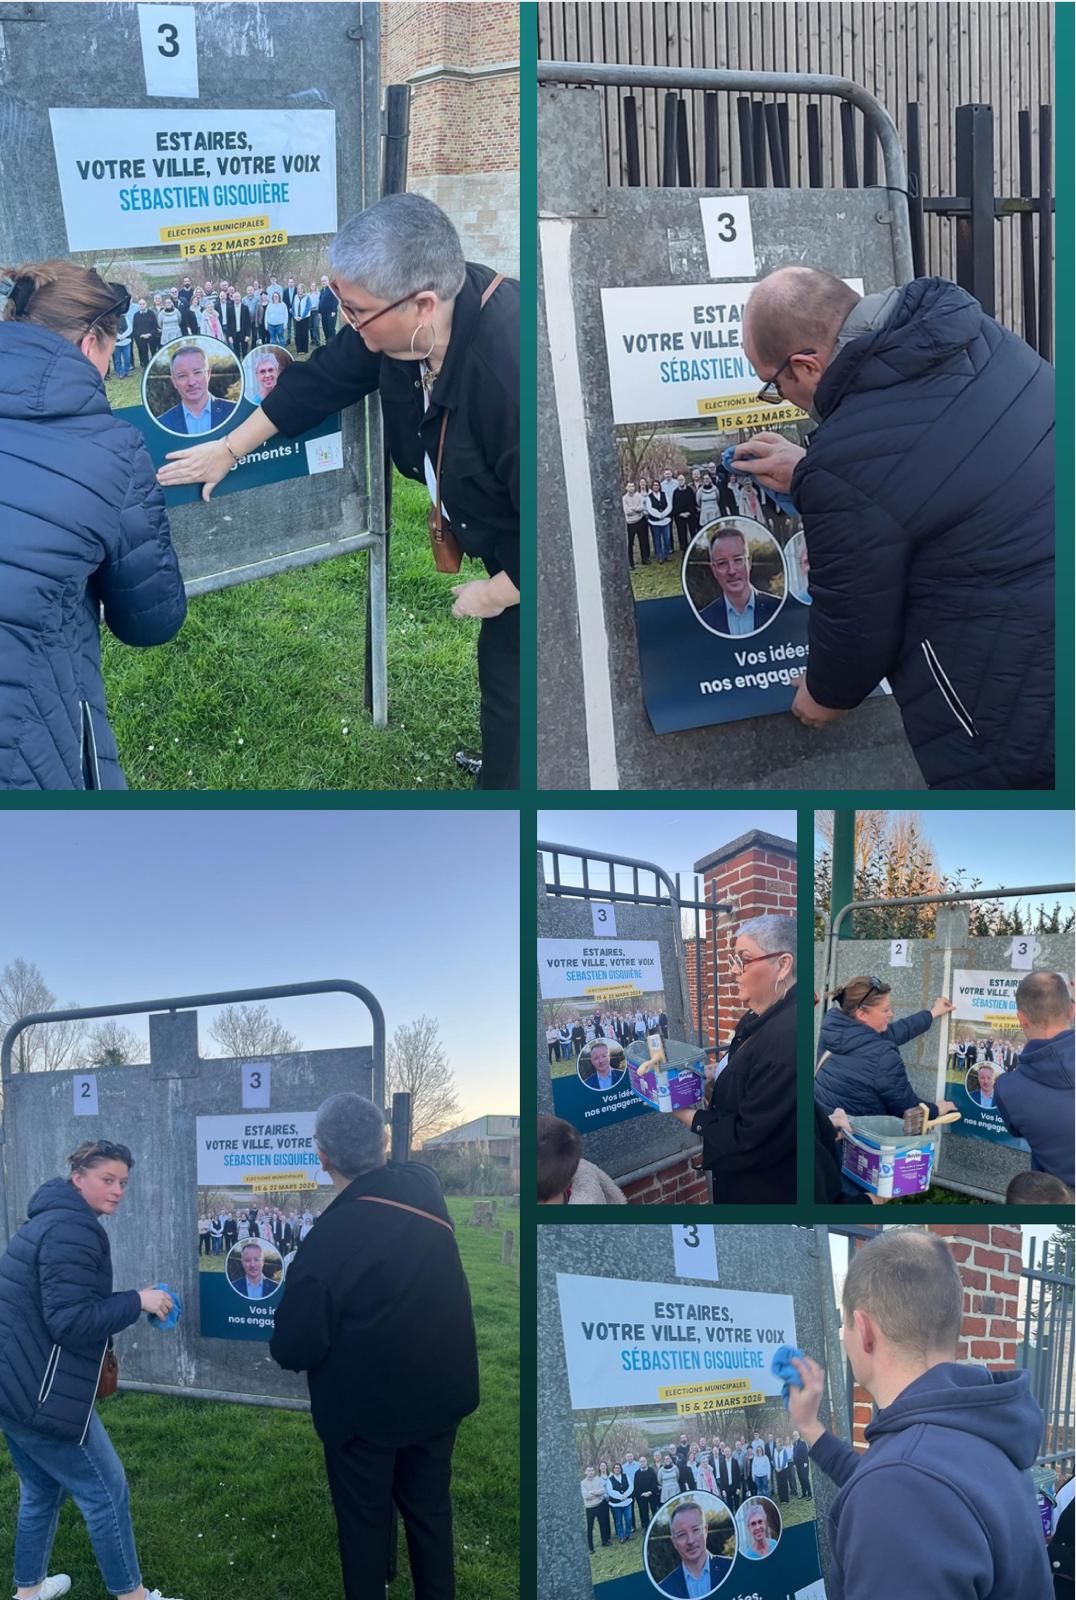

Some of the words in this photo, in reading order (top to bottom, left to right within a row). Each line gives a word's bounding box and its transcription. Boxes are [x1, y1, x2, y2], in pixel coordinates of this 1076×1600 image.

[157, 24, 180, 57] 3
[156, 131, 253, 151] ESTAIRES,
[76, 159, 146, 180] VOTRE
[152, 157, 211, 178] VILLE,
[217, 156, 276, 175] VOTRE
[283, 154, 321, 173] VOIX
[119, 184, 209, 211] SÉBASTIEN
[213, 180, 290, 207] GISQUIÈRE
[167, 225, 211, 238] ELECTIONS
[213, 219, 265, 232] MUNICIPALES
[717, 212, 737, 242] 3
[184, 245, 196, 255] 15
[199, 243, 207, 253] &
[210, 241, 223, 252] 22
[225, 237, 256, 250] MARS
[258, 233, 284, 246] 2026
[622, 332, 684, 353] VOTRE
[660, 357, 744, 384] SÉBASTIEN
[704, 398, 746, 409] ELECTIONS
[721, 418, 732, 427] 15
[735, 416, 743, 425] &
[747, 414, 758, 424] 22
[762, 409, 791, 422] MARS
[734, 651, 767, 666] Vos
[700, 679, 732, 695] nos
[598, 909, 607, 921] 3
[583, 948, 625, 957] ESTAIRES,
[895, 944, 902, 954] 2
[1018, 943, 1028, 955] 3
[547, 959, 578, 967] VOTRE
[581, 958, 608, 967] VILLE,
[610, 958, 635, 966] VOTRE
[960, 987, 984, 995] VOTRE
[250, 1072, 261, 1088] 3
[81, 1082, 90, 1097] 2
[602, 1094, 617, 1103] Vos
[584, 1108, 600, 1118] nos
[963, 1117, 977, 1125] nos
[981, 1112, 994, 1121] Vos
[244, 1124, 298, 1136] ESTAIRES,
[205, 1140, 238, 1150] VOTRE
[242, 1139, 273, 1150] VILLE,
[277, 1137, 312, 1149] VOTRE
[223, 1153, 271, 1166] SÉBASTIEN
[273, 1150, 320, 1166] GISQUIÈRE
[682, 1224, 700, 1248] 3
[249, 1306, 267, 1315] Vos
[654, 1302, 734, 1324] ESTAIRES,
[581, 1322, 645, 1341] VOTRE
[651, 1325, 701, 1344] VILLE,
[705, 1326, 751, 1343] VOTRE
[756, 1329, 785, 1344] VOIX
[621, 1346, 700, 1371] SÉBASTIEN
[704, 1347, 765, 1370] GISQUIÈRE
[665, 1386, 703, 1397] ELECTIONS
[705, 1381, 747, 1392] MUNICIPALES
[680, 1403, 691, 1412] 15
[694, 1402, 700, 1411] &
[704, 1400, 714, 1410] 22
[716, 1397, 740, 1408] MARS
[742, 1394, 762, 1404] 2026
